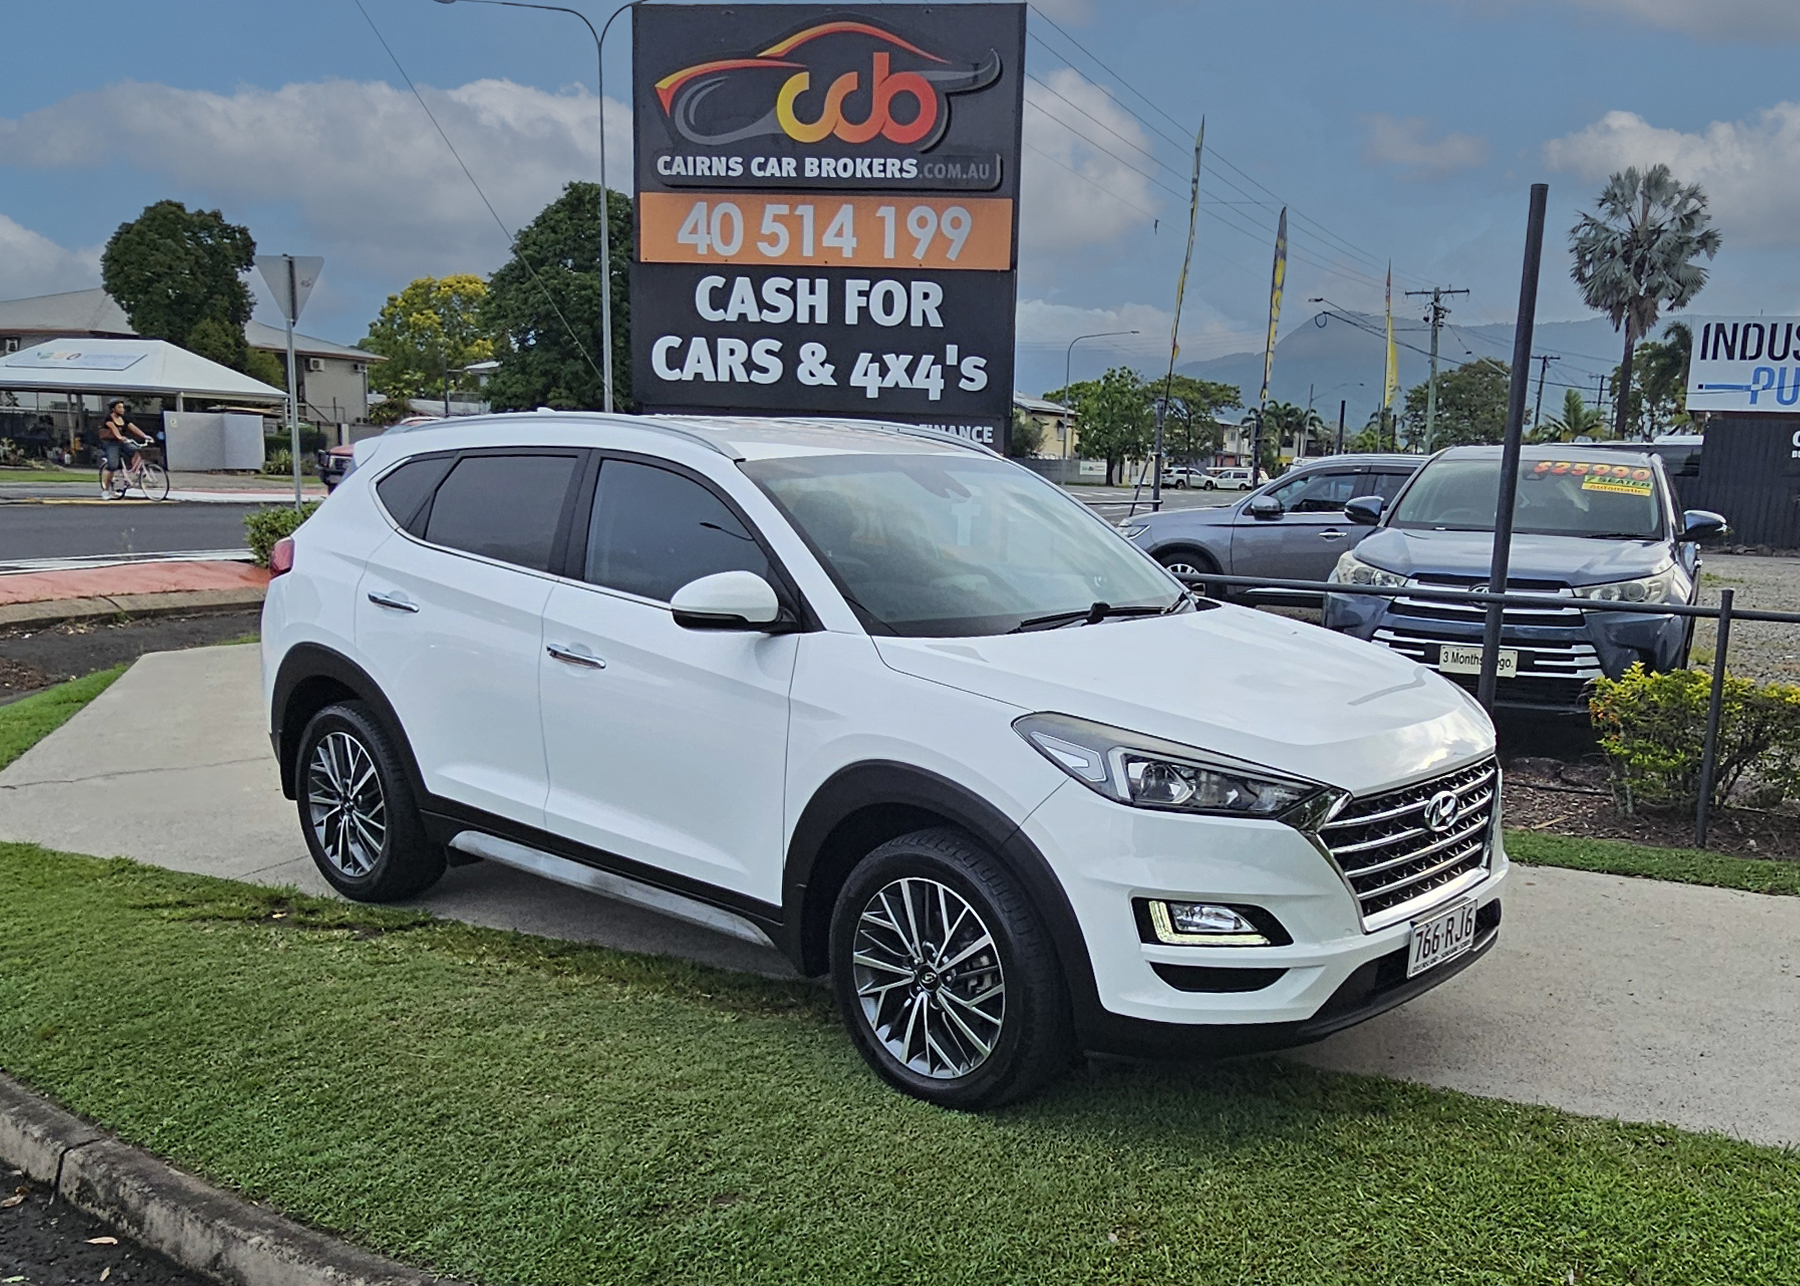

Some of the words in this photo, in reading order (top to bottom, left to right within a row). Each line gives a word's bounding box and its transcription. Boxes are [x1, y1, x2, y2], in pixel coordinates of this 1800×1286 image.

[656, 155, 744, 178] CAIRNS
[750, 157, 798, 178] CAR
[677, 201, 744, 257] 40
[756, 203, 858, 258] 514
[875, 205, 973, 262] 199
[694, 275, 829, 325] CASH
[844, 278, 944, 328] FOR
[651, 335, 784, 385] CARS
[796, 341, 838, 387] &
[1700, 322, 1800, 362] INDU
[919, 424, 994, 444] ANCE
[1442, 651, 1449, 663] 3
[1497, 658, 1514, 671] go.
